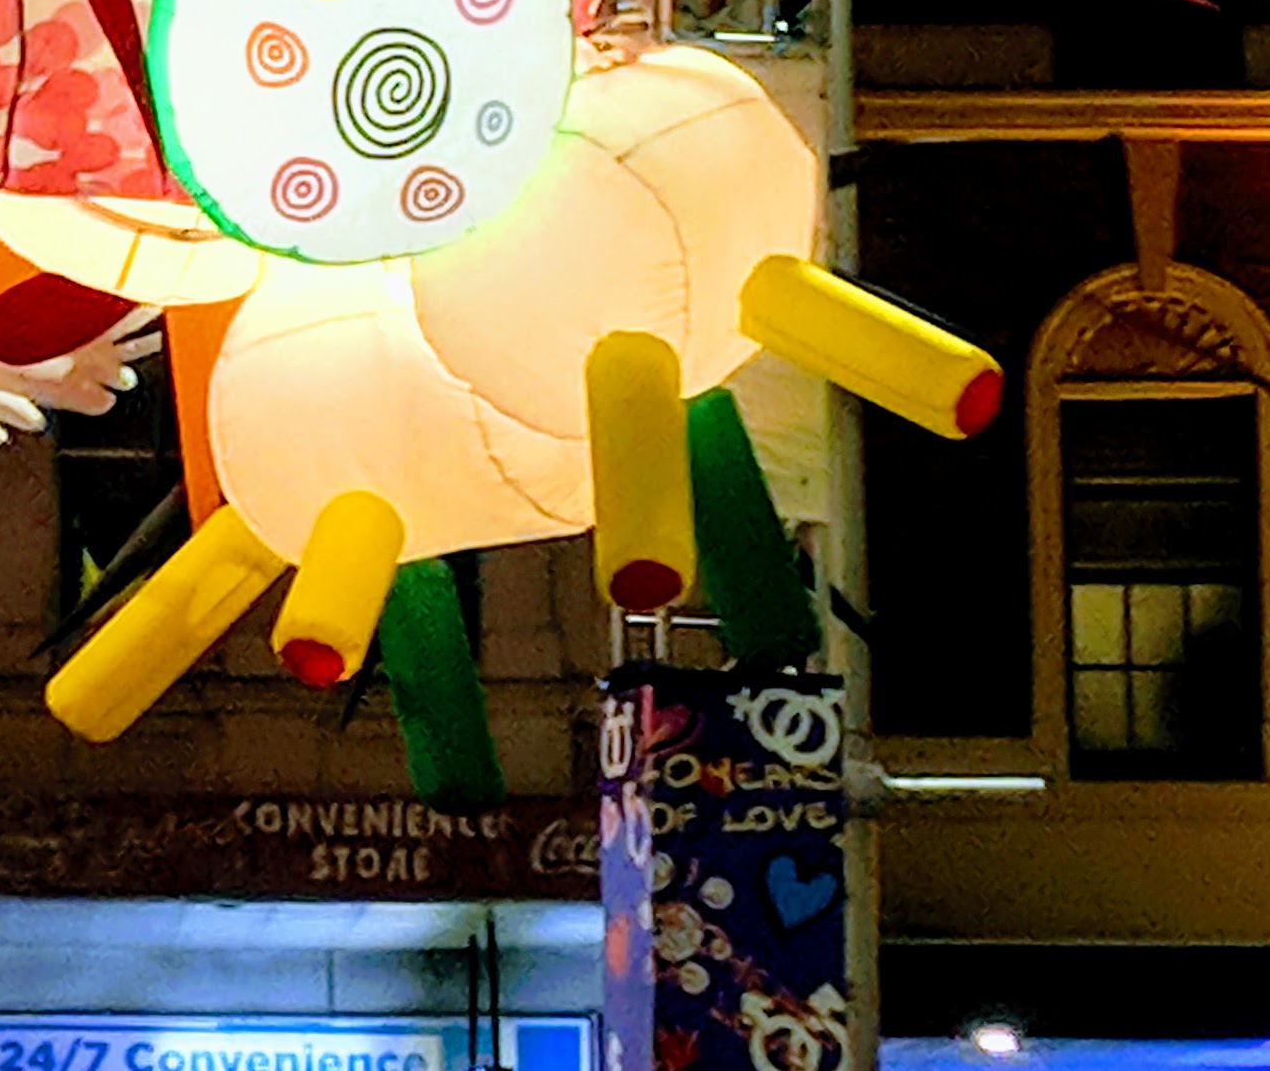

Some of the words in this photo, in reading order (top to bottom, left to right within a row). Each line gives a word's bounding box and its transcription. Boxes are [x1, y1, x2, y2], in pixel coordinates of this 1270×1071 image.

[650, 801, 697, 834] OF
[722, 801, 838, 832] LOVE
[309, 843, 431, 883] STORE
[125, 1041, 429, 1071] Convenience
